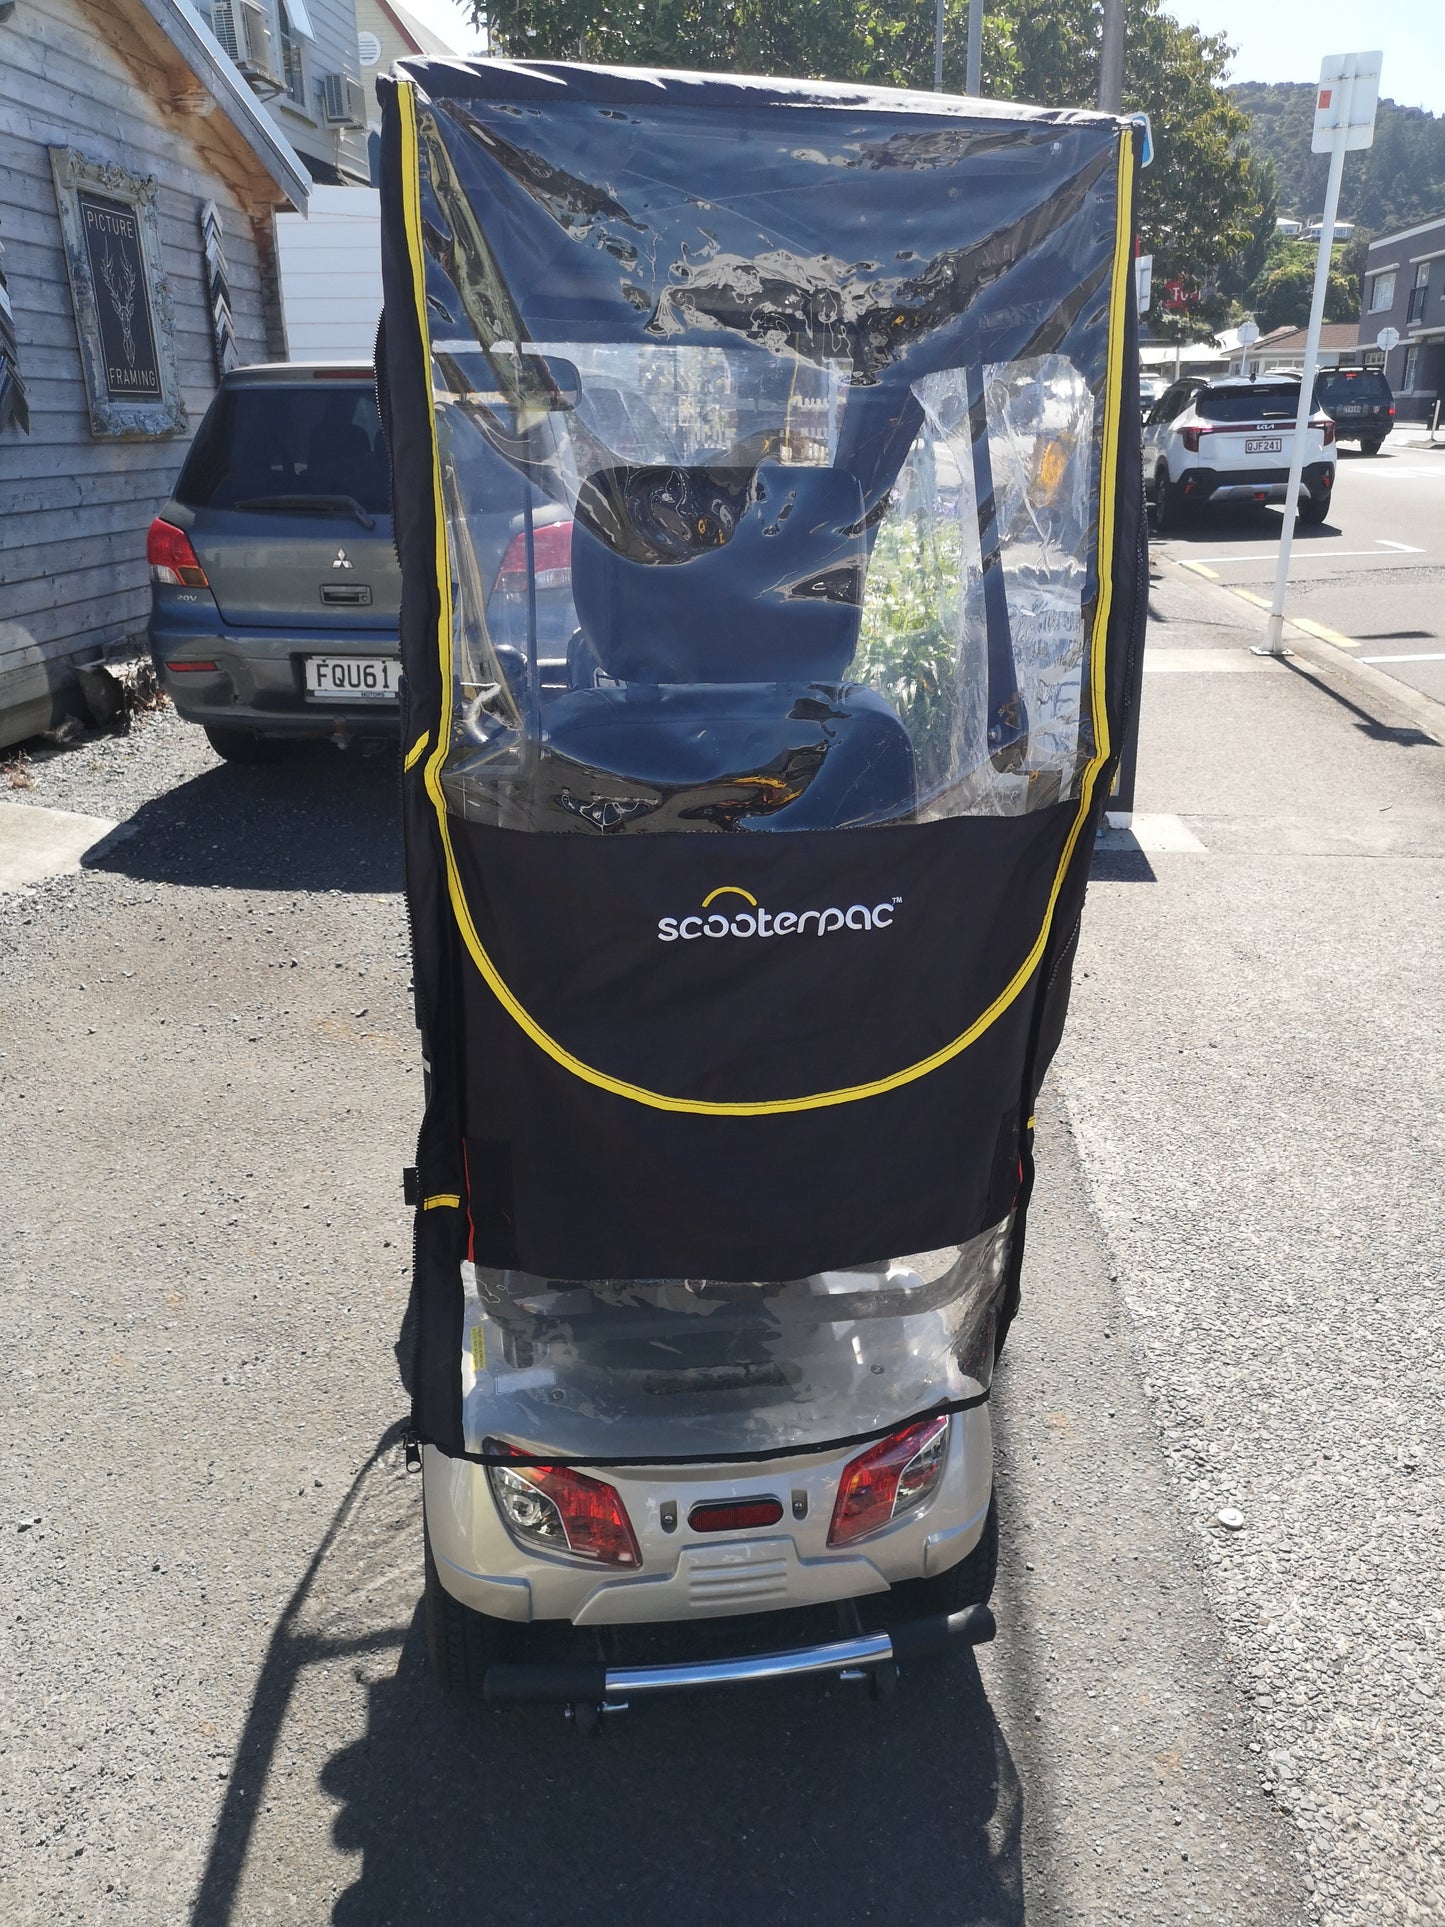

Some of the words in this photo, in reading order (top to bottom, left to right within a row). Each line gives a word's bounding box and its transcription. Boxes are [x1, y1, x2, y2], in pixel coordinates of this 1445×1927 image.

[87, 210, 135, 239] PICTURE
[109, 367, 156, 388] FRAMING
[316, 663, 390, 689] FQU61
[657, 904, 895, 942] scooterpac
